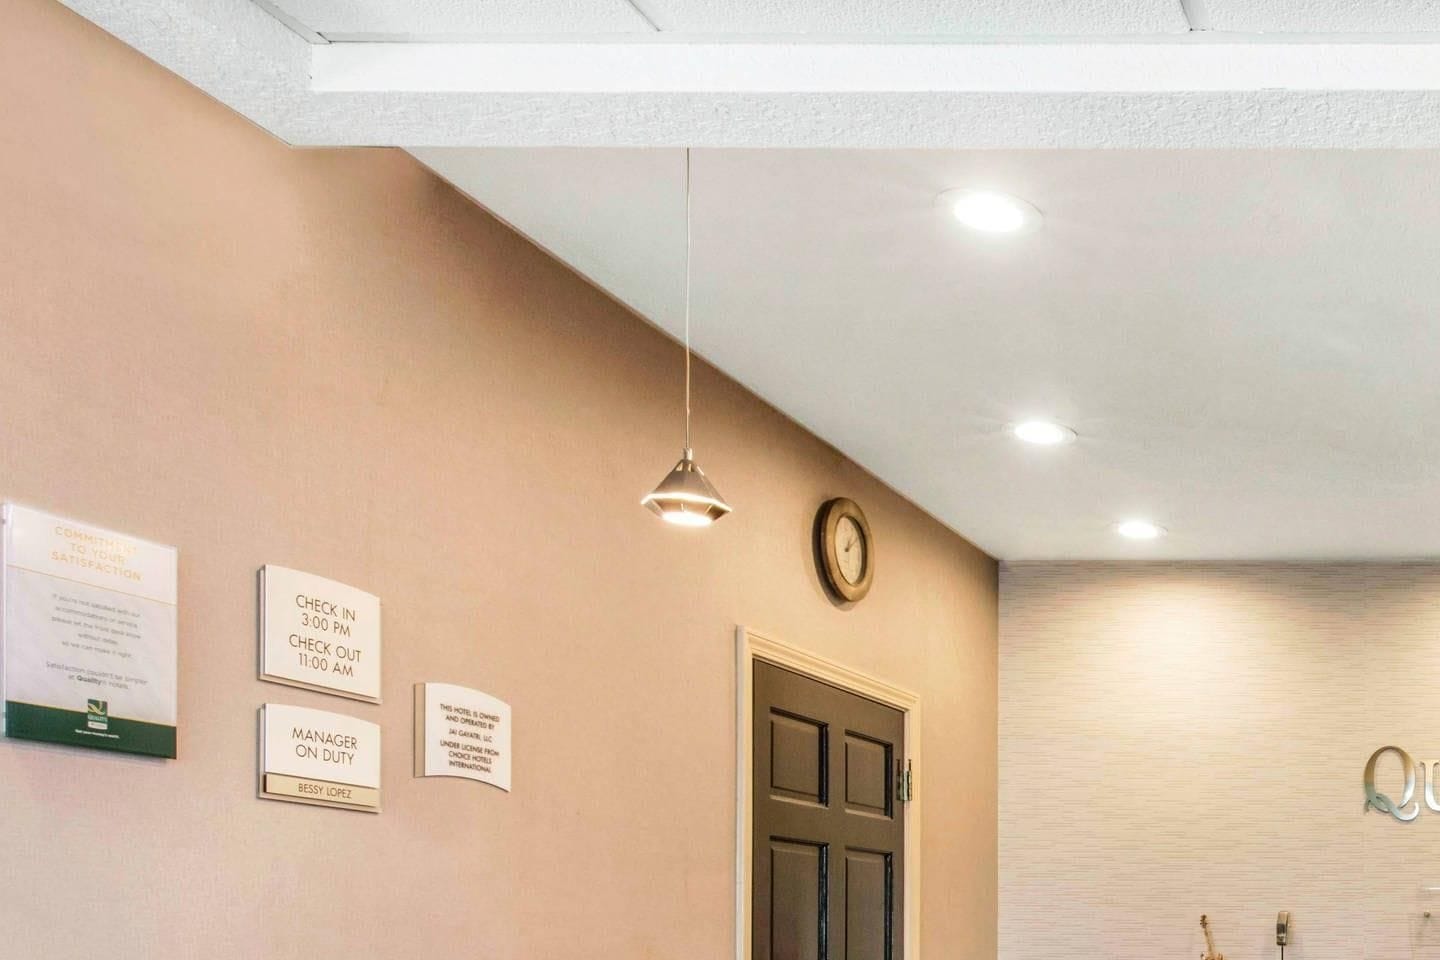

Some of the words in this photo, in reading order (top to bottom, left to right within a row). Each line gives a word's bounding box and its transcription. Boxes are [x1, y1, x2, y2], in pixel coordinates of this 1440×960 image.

[55, 526, 137, 555] COMMITM
[71, 543, 85, 554] TO
[92, 547, 127, 565] YOUR
[51, 551, 142, 581] SATISFACTION
[295, 594, 337, 617] CHECK
[342, 606, 356, 622] IN
[301, 612, 329, 632] 3:00
[333, 621, 351, 637] PM
[288, 634, 331, 656] CHECK
[336, 645, 361, 662] OUT
[298, 653, 328, 672] 11:00
[332, 662, 354, 677] AM
[440, 703, 453, 712] THIS
[454, 706, 472, 717] HOTEL
[479, 712, 500, 722] OWNED
[445, 715, 459, 723] AND
[460, 717, 488, 729] OPERATED
[292, 727, 358, 750] MANAGER
[440, 740, 460, 749] UNDER
[462, 744, 483, 754] LICENSE
[484, 749, 500, 757] FROM
[295, 745, 317, 759] ON
[323, 750, 355, 766] DUTY
[448, 751, 471, 760] CHOICE
[472, 756, 492, 765] HOTELS
[448, 760, 492, 773] INTERNATIONAL
[298, 782, 324, 795] BESSY
[326, 786, 352, 799] LOPEZ
